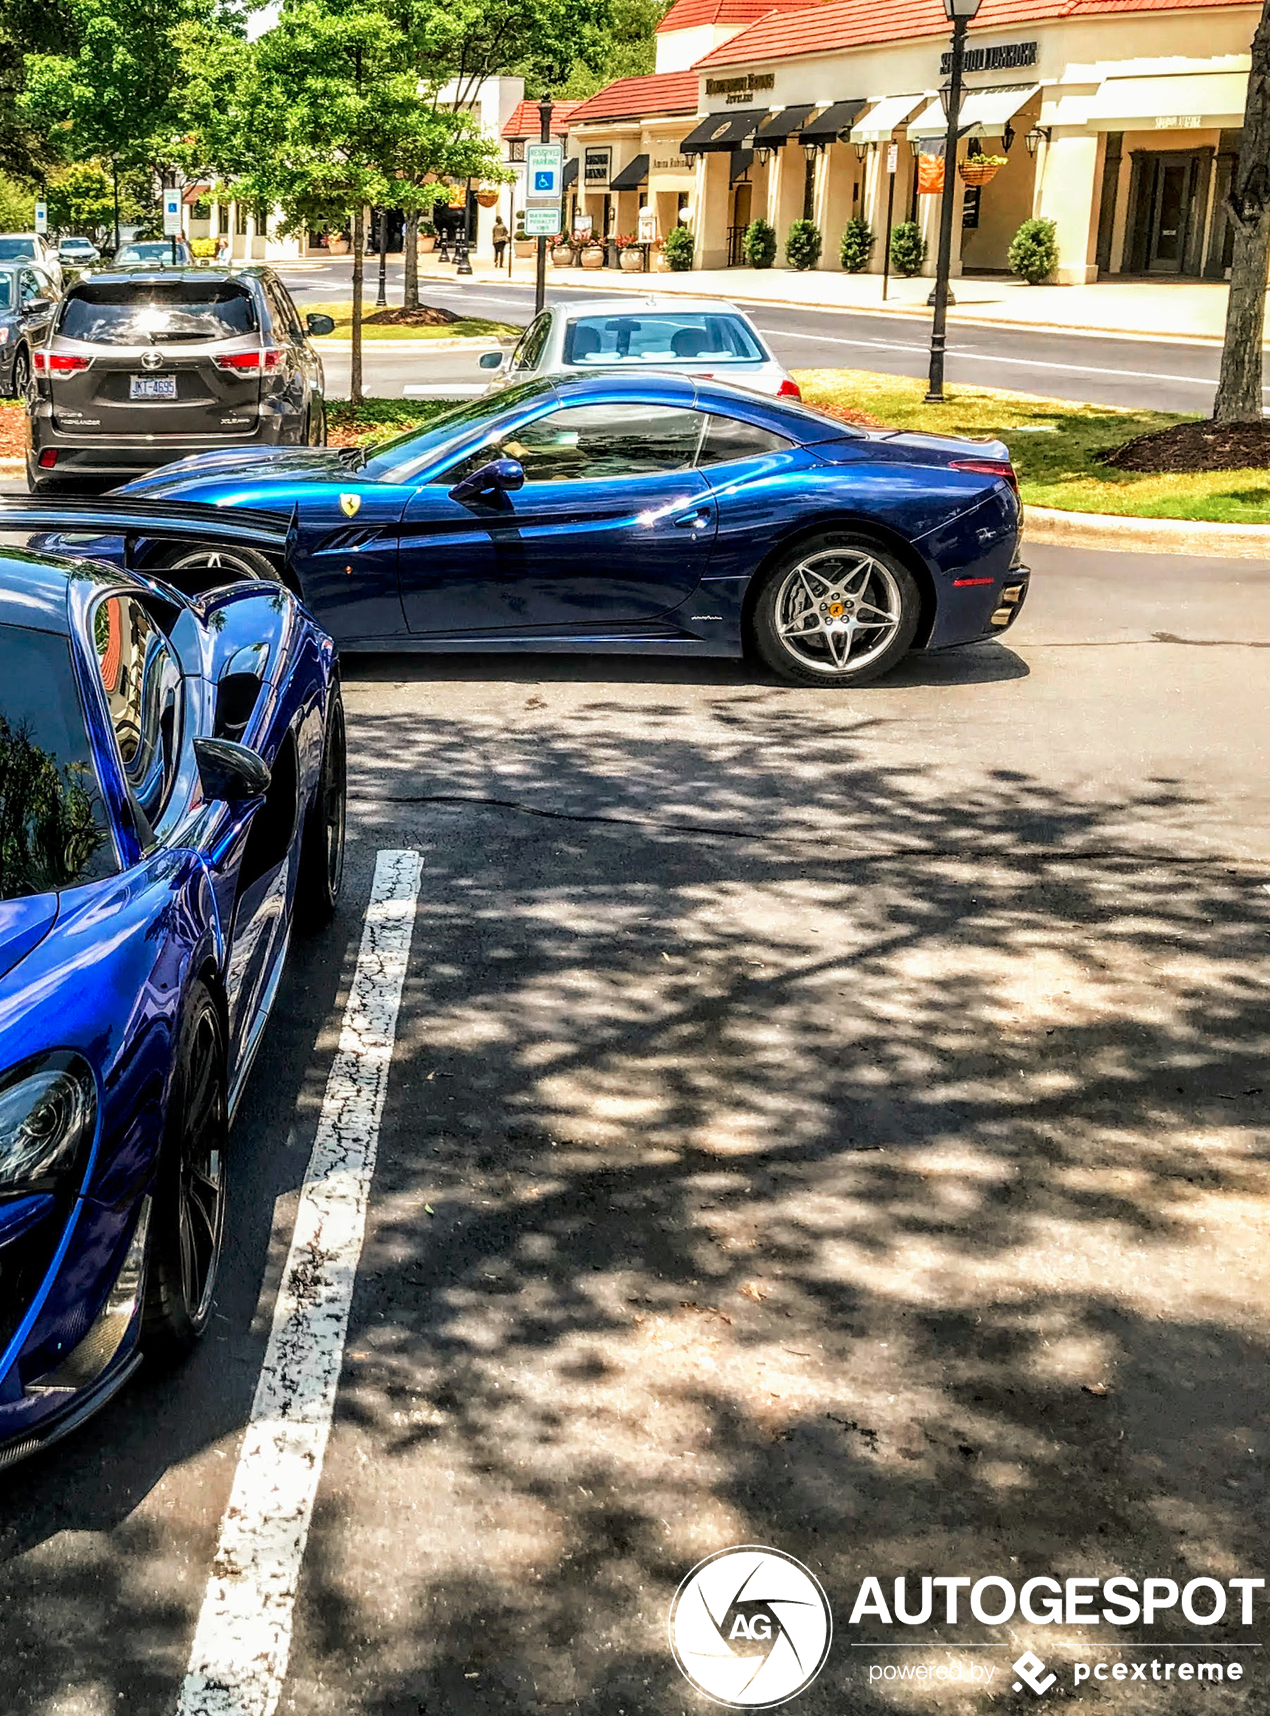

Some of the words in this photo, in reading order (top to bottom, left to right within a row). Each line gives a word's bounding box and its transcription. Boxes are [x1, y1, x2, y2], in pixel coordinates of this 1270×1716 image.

[530, 148, 561, 157] RESERVED
[533, 158, 558, 166] PARKING
[132, 380, 175, 394] JKT-4695
